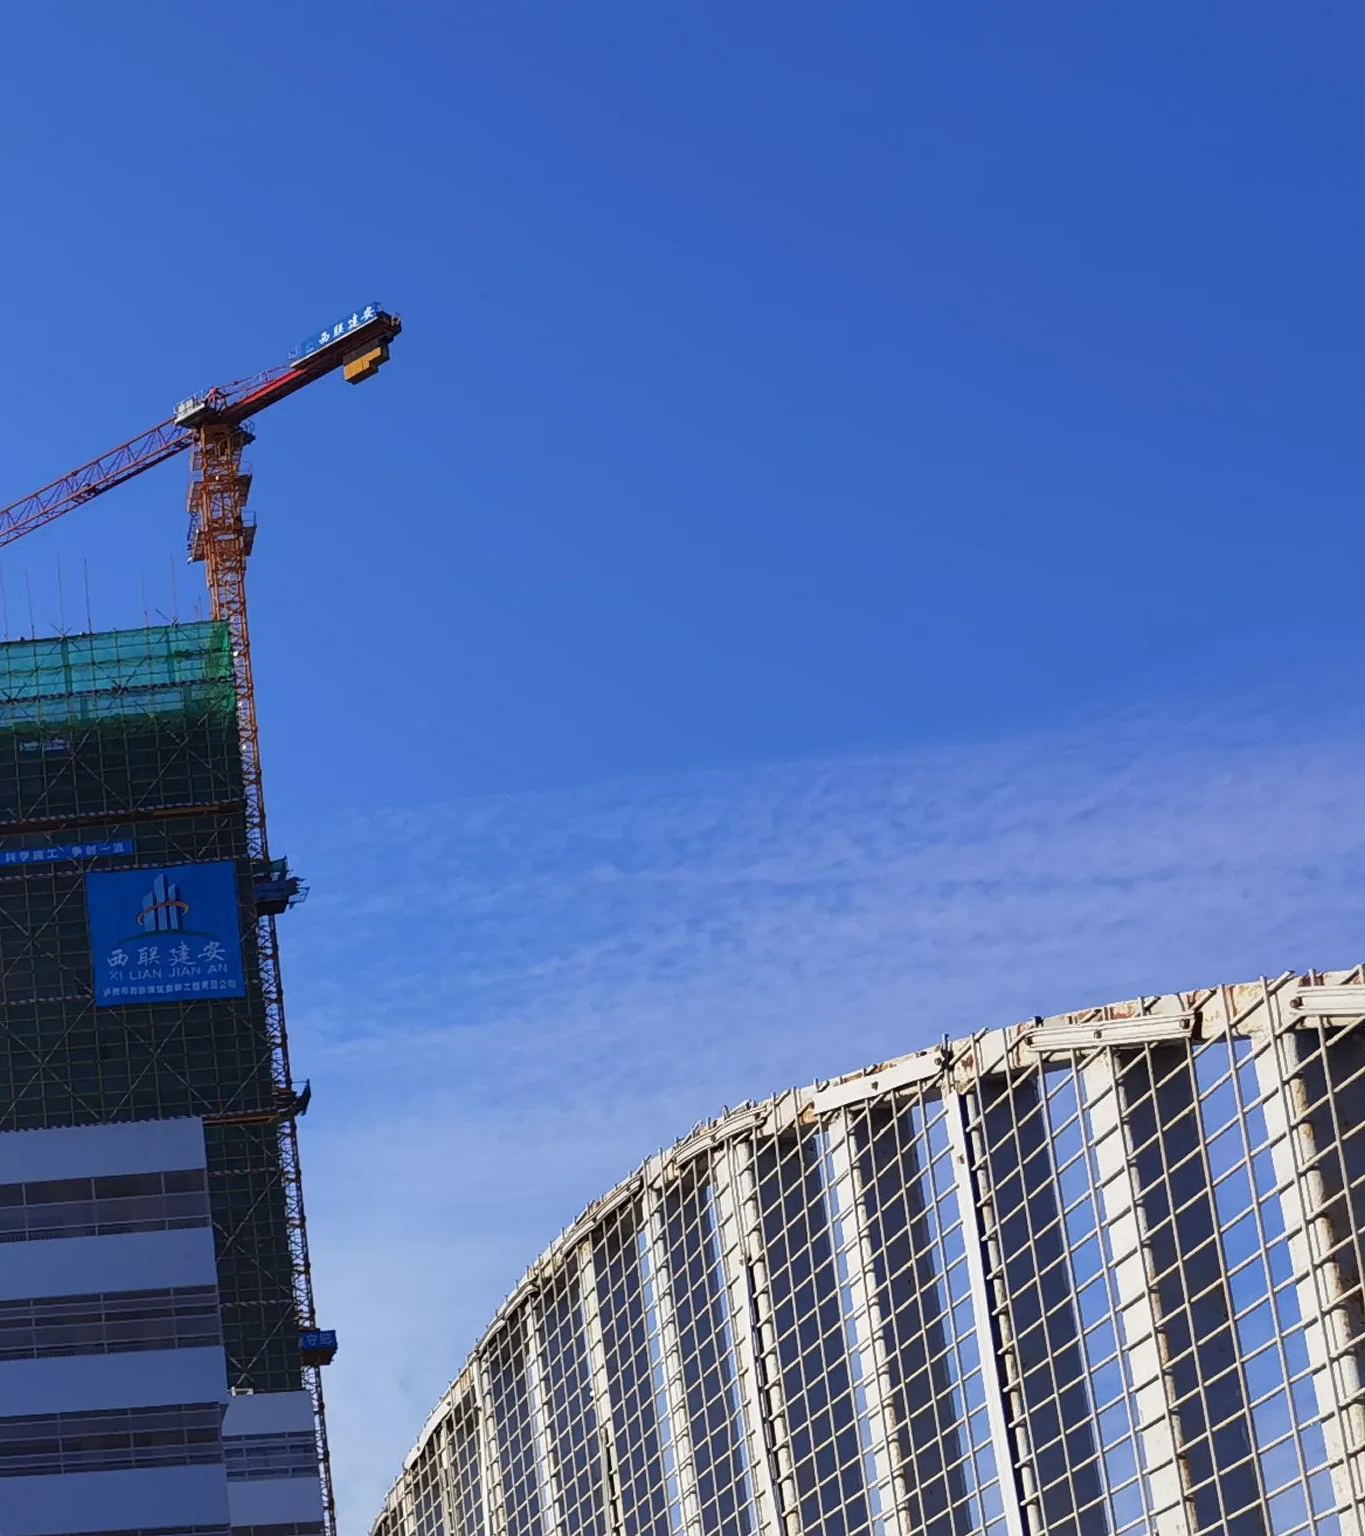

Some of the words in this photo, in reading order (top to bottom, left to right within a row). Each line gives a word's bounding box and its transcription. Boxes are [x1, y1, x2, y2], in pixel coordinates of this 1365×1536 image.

[107, 940, 226, 968] 西联建安
[109, 970, 124, 982] XI
[129, 968, 162, 981] LIAN
[168, 965, 201, 978] JIAN
[207, 963, 228, 975] AN
